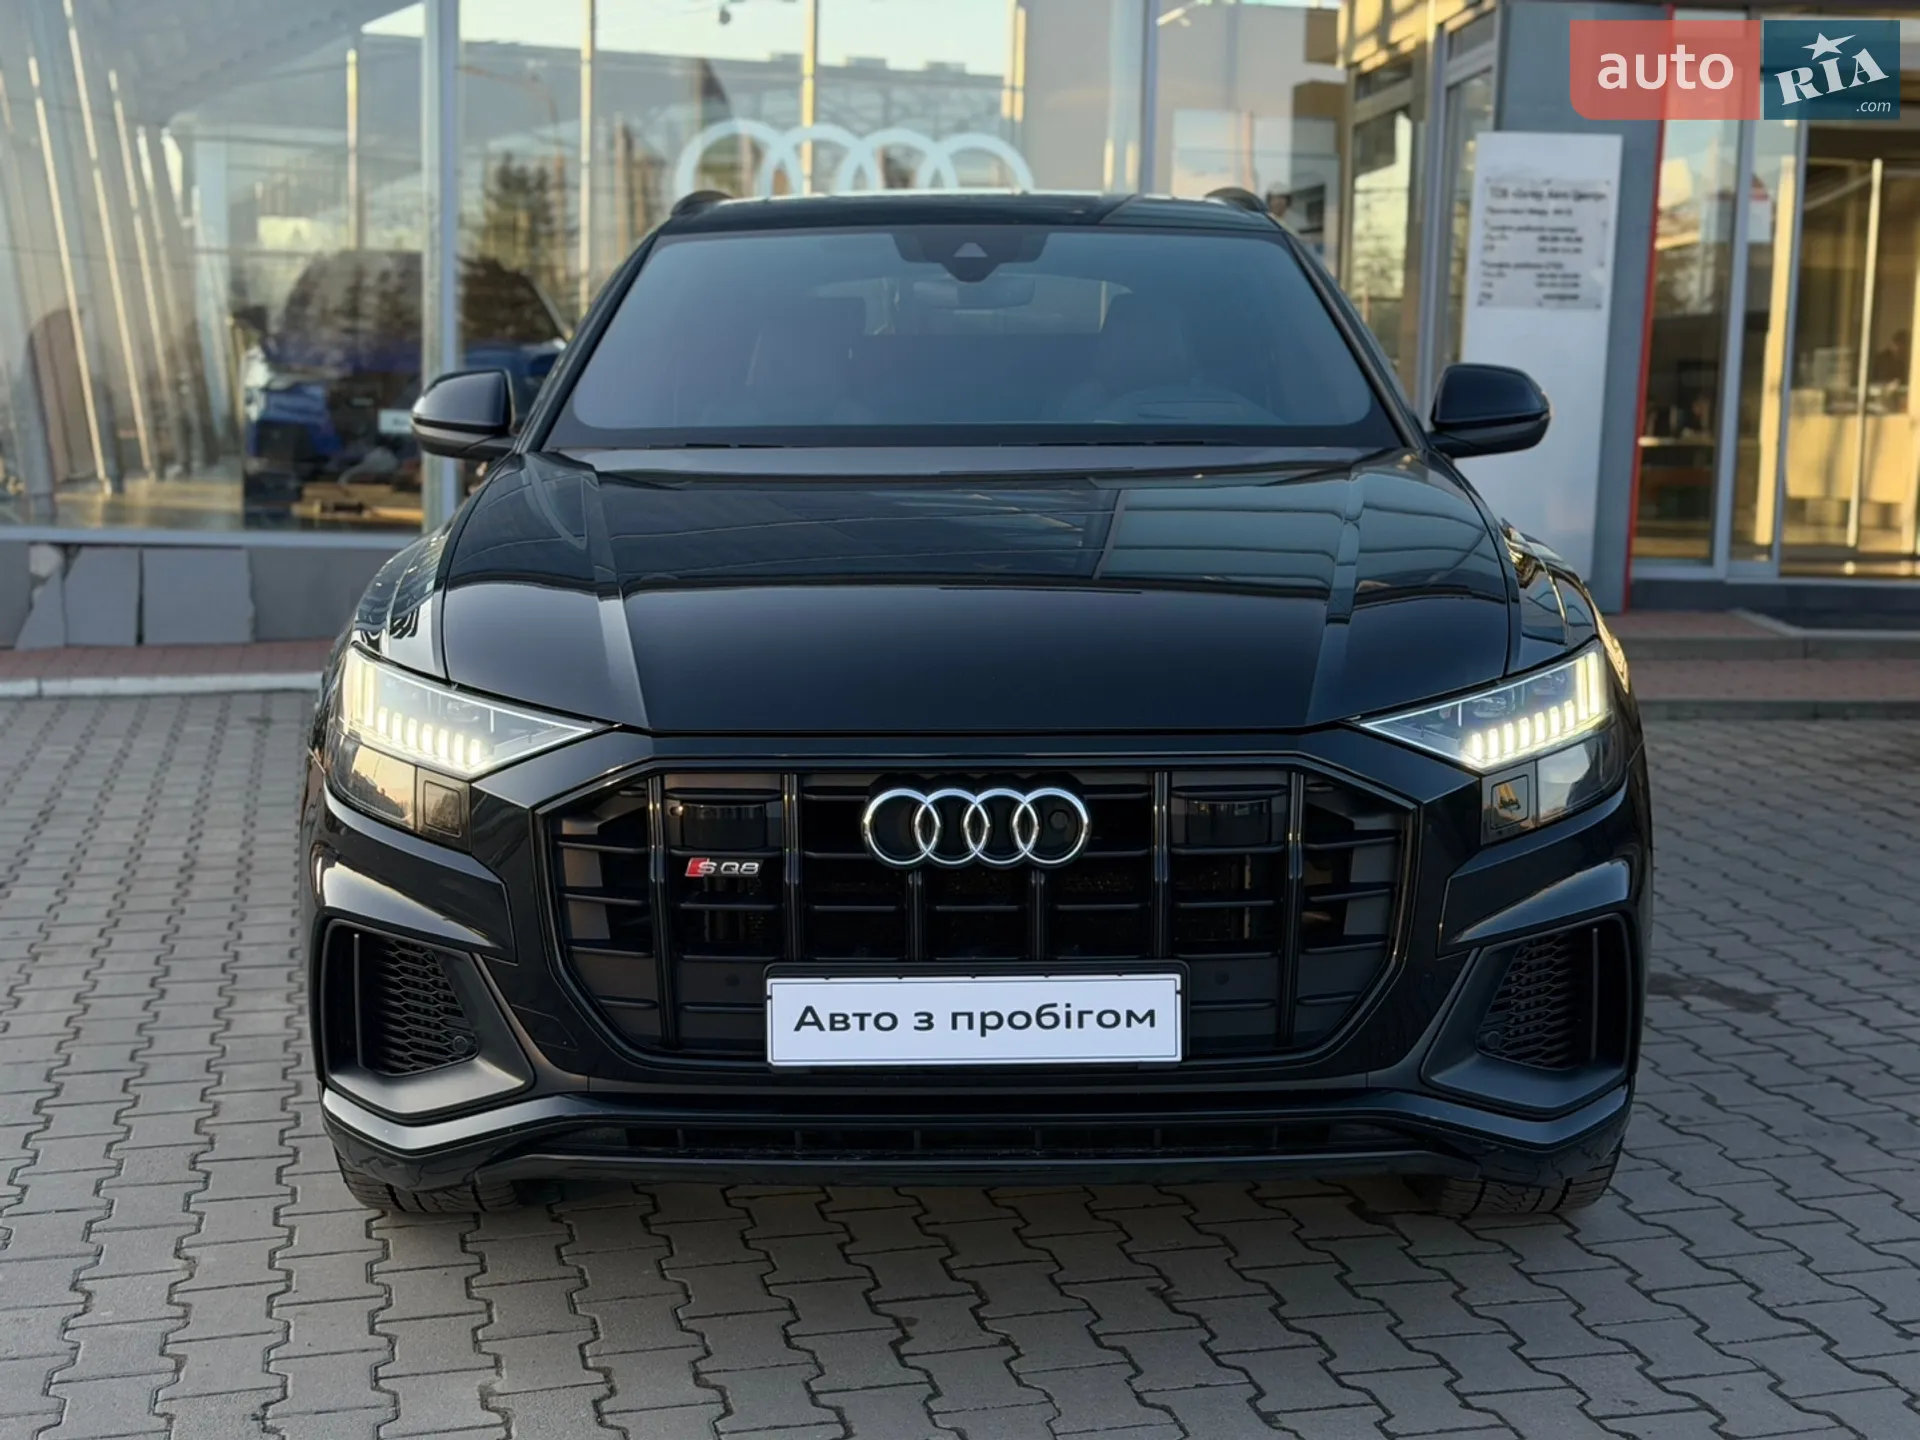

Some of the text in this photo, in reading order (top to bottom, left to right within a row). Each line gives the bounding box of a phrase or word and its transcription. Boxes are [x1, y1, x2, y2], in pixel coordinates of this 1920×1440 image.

[793, 1002, 1156, 1037] Авто з пробігом
